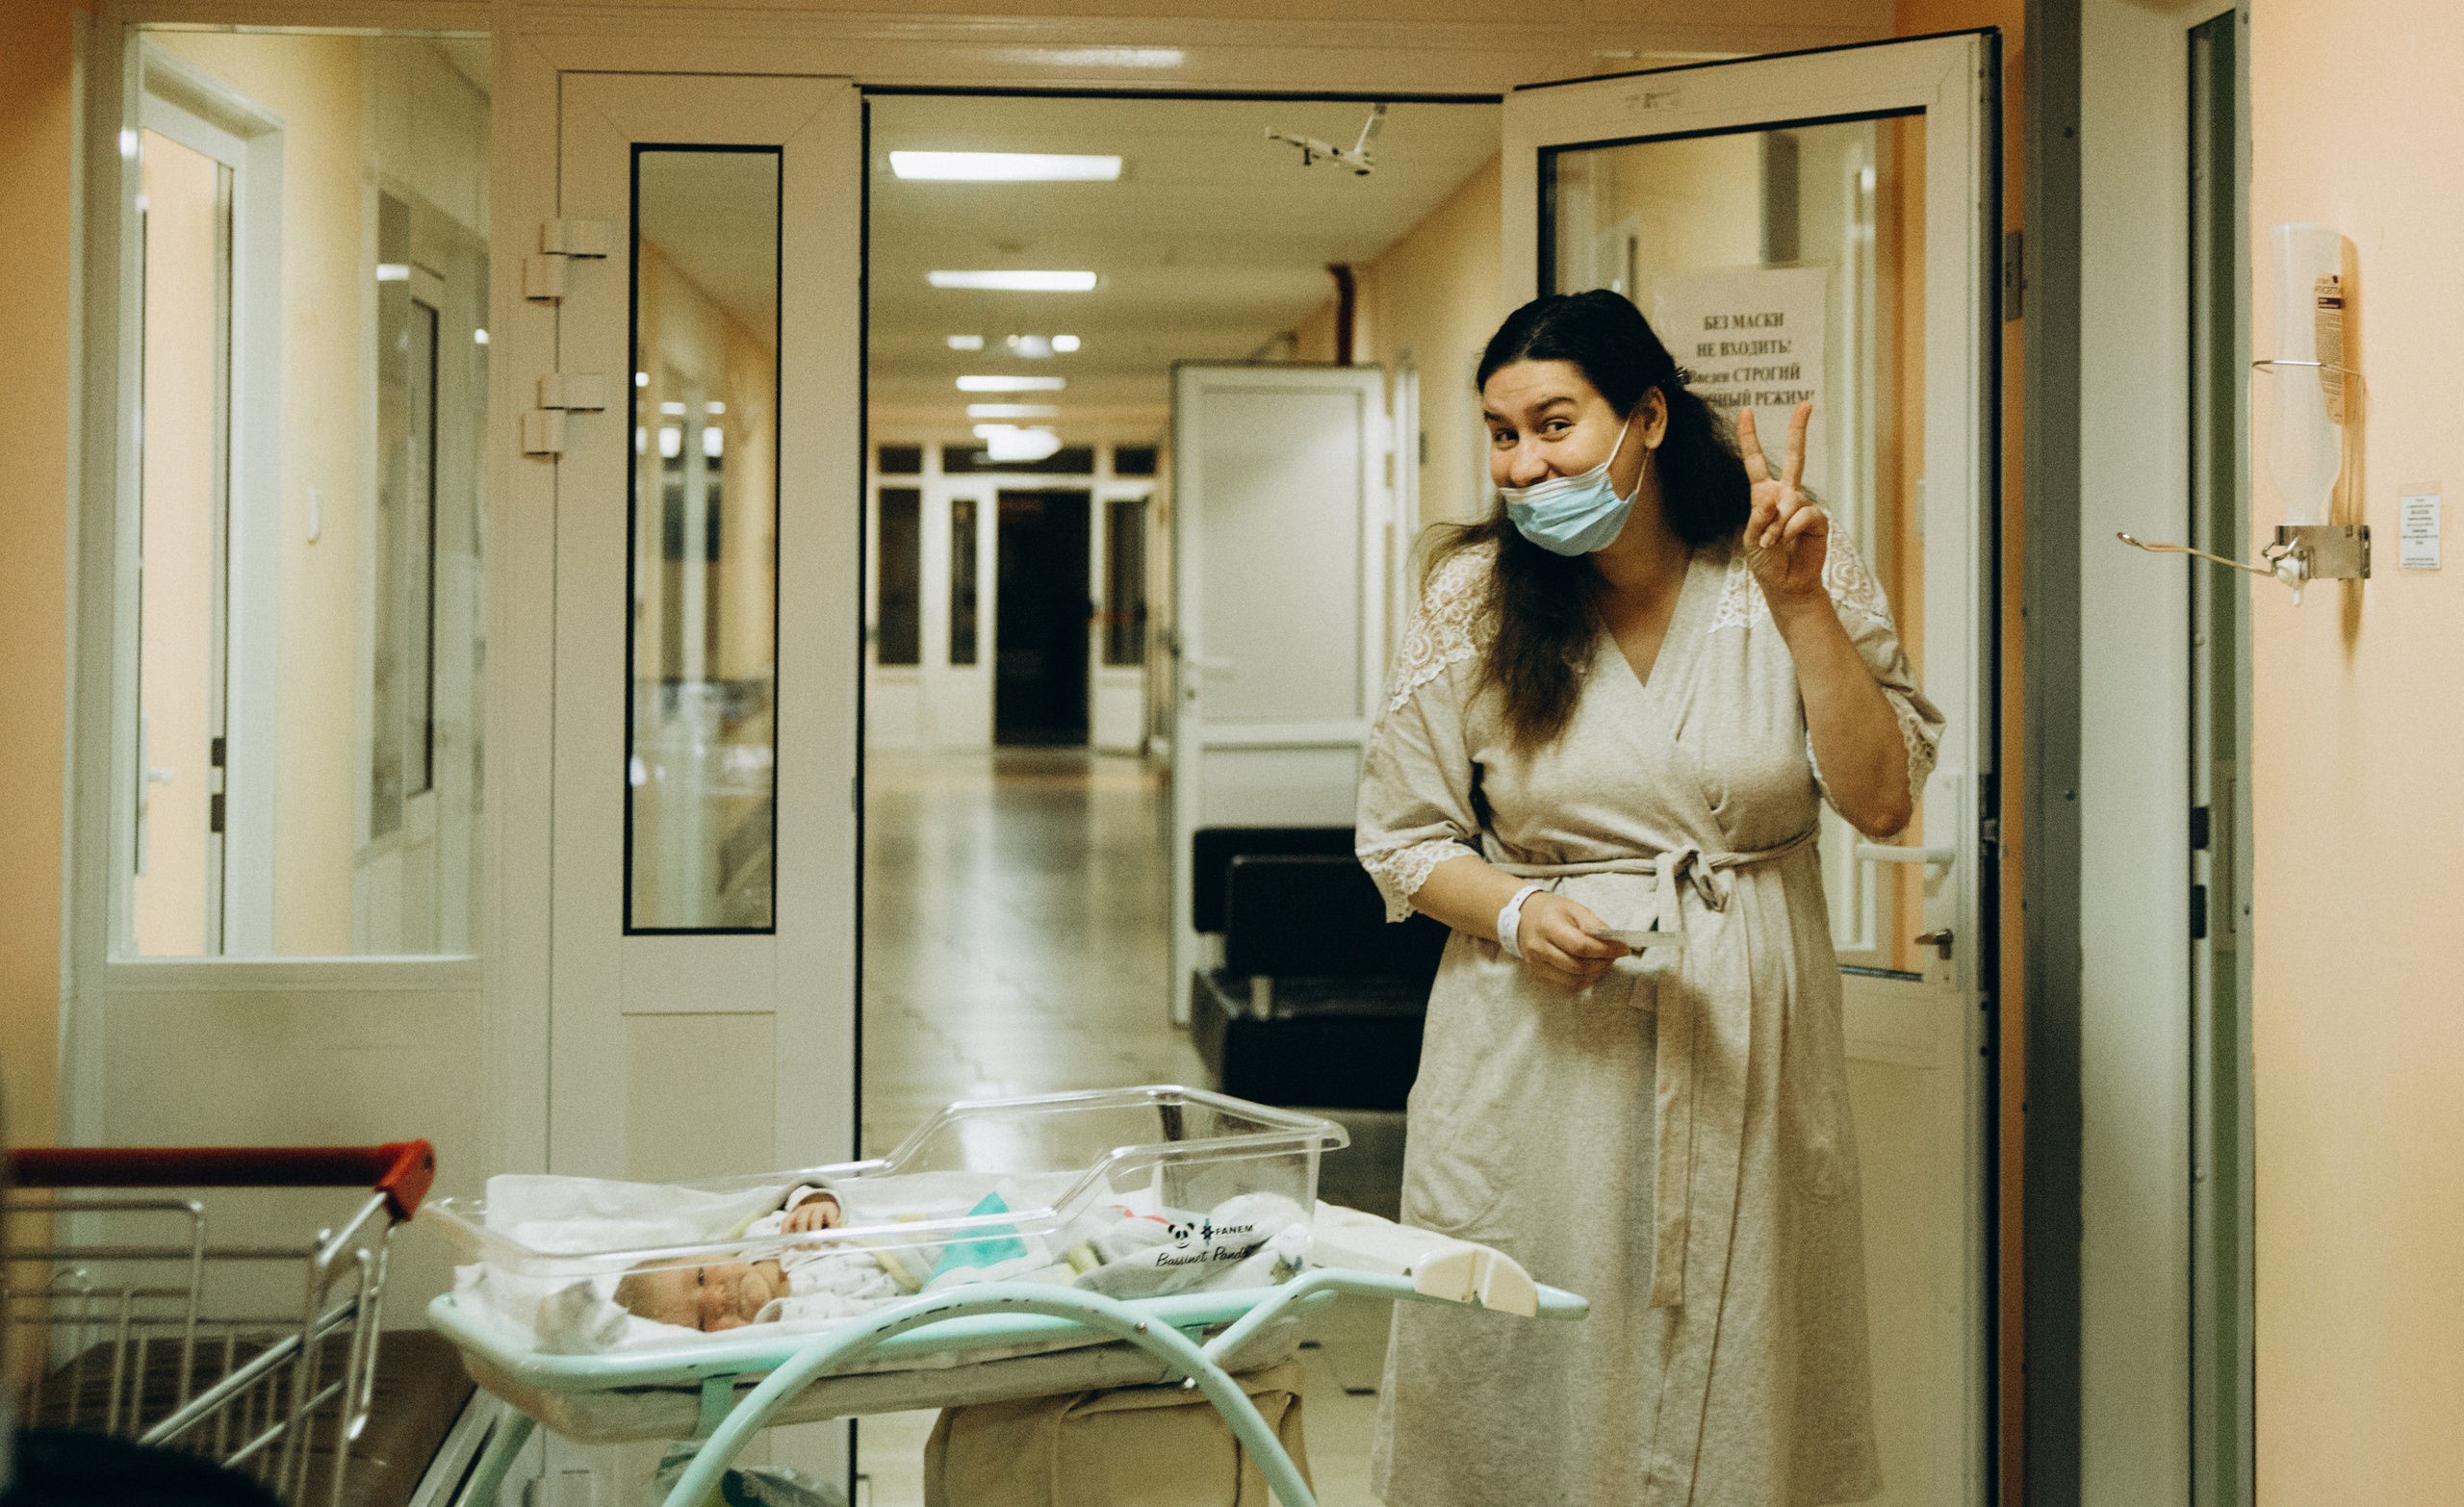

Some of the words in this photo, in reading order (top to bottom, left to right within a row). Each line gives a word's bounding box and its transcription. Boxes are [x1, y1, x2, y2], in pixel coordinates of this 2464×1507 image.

[1705, 316, 1729, 330] БЕЗ
[1732, 313, 1784, 329] МАСКИ
[1697, 343, 1716, 357] НЕ
[1721, 340, 1792, 357] ВХОДИТЬ!
[1733, 363, 1800, 381] СТРОГИЙ
[1216, 1225, 1253, 1236] FANEM
[1156, 1251, 1209, 1266] Bassinet
